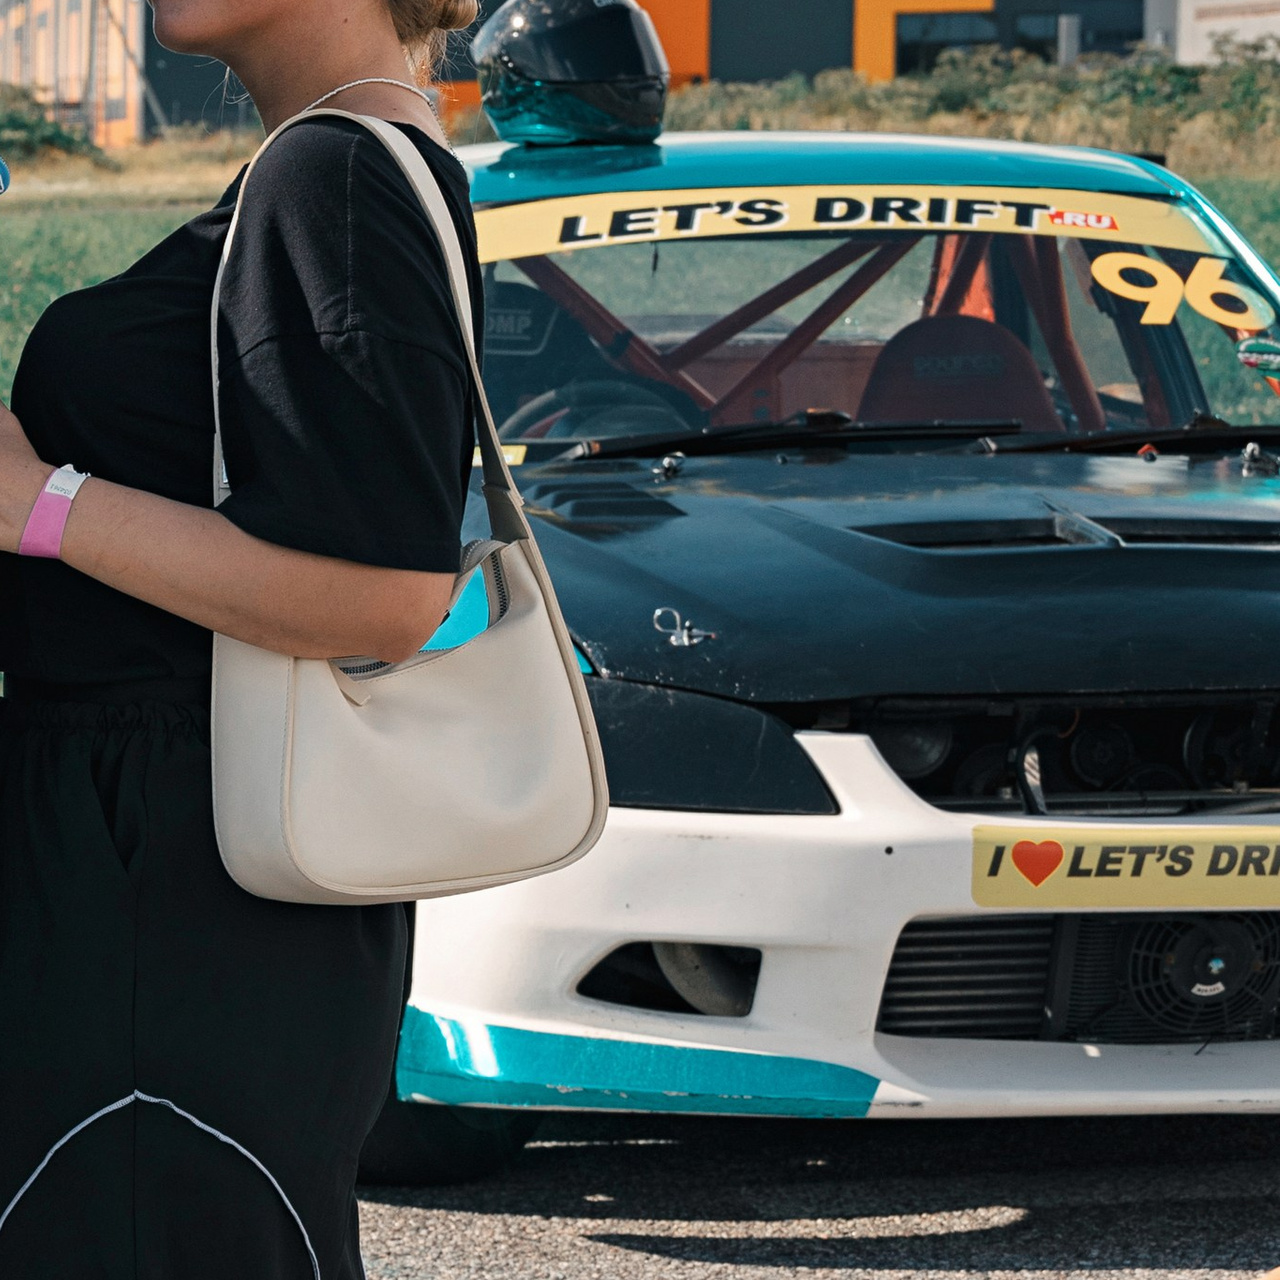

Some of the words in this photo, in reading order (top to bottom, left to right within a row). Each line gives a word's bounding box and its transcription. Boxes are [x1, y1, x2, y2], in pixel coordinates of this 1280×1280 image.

[558, 198, 787, 246] LET'S
[1090, 251, 1276, 331] 96
[986, 845, 1006, 877] I
[1066, 844, 1195, 877] LET'S
